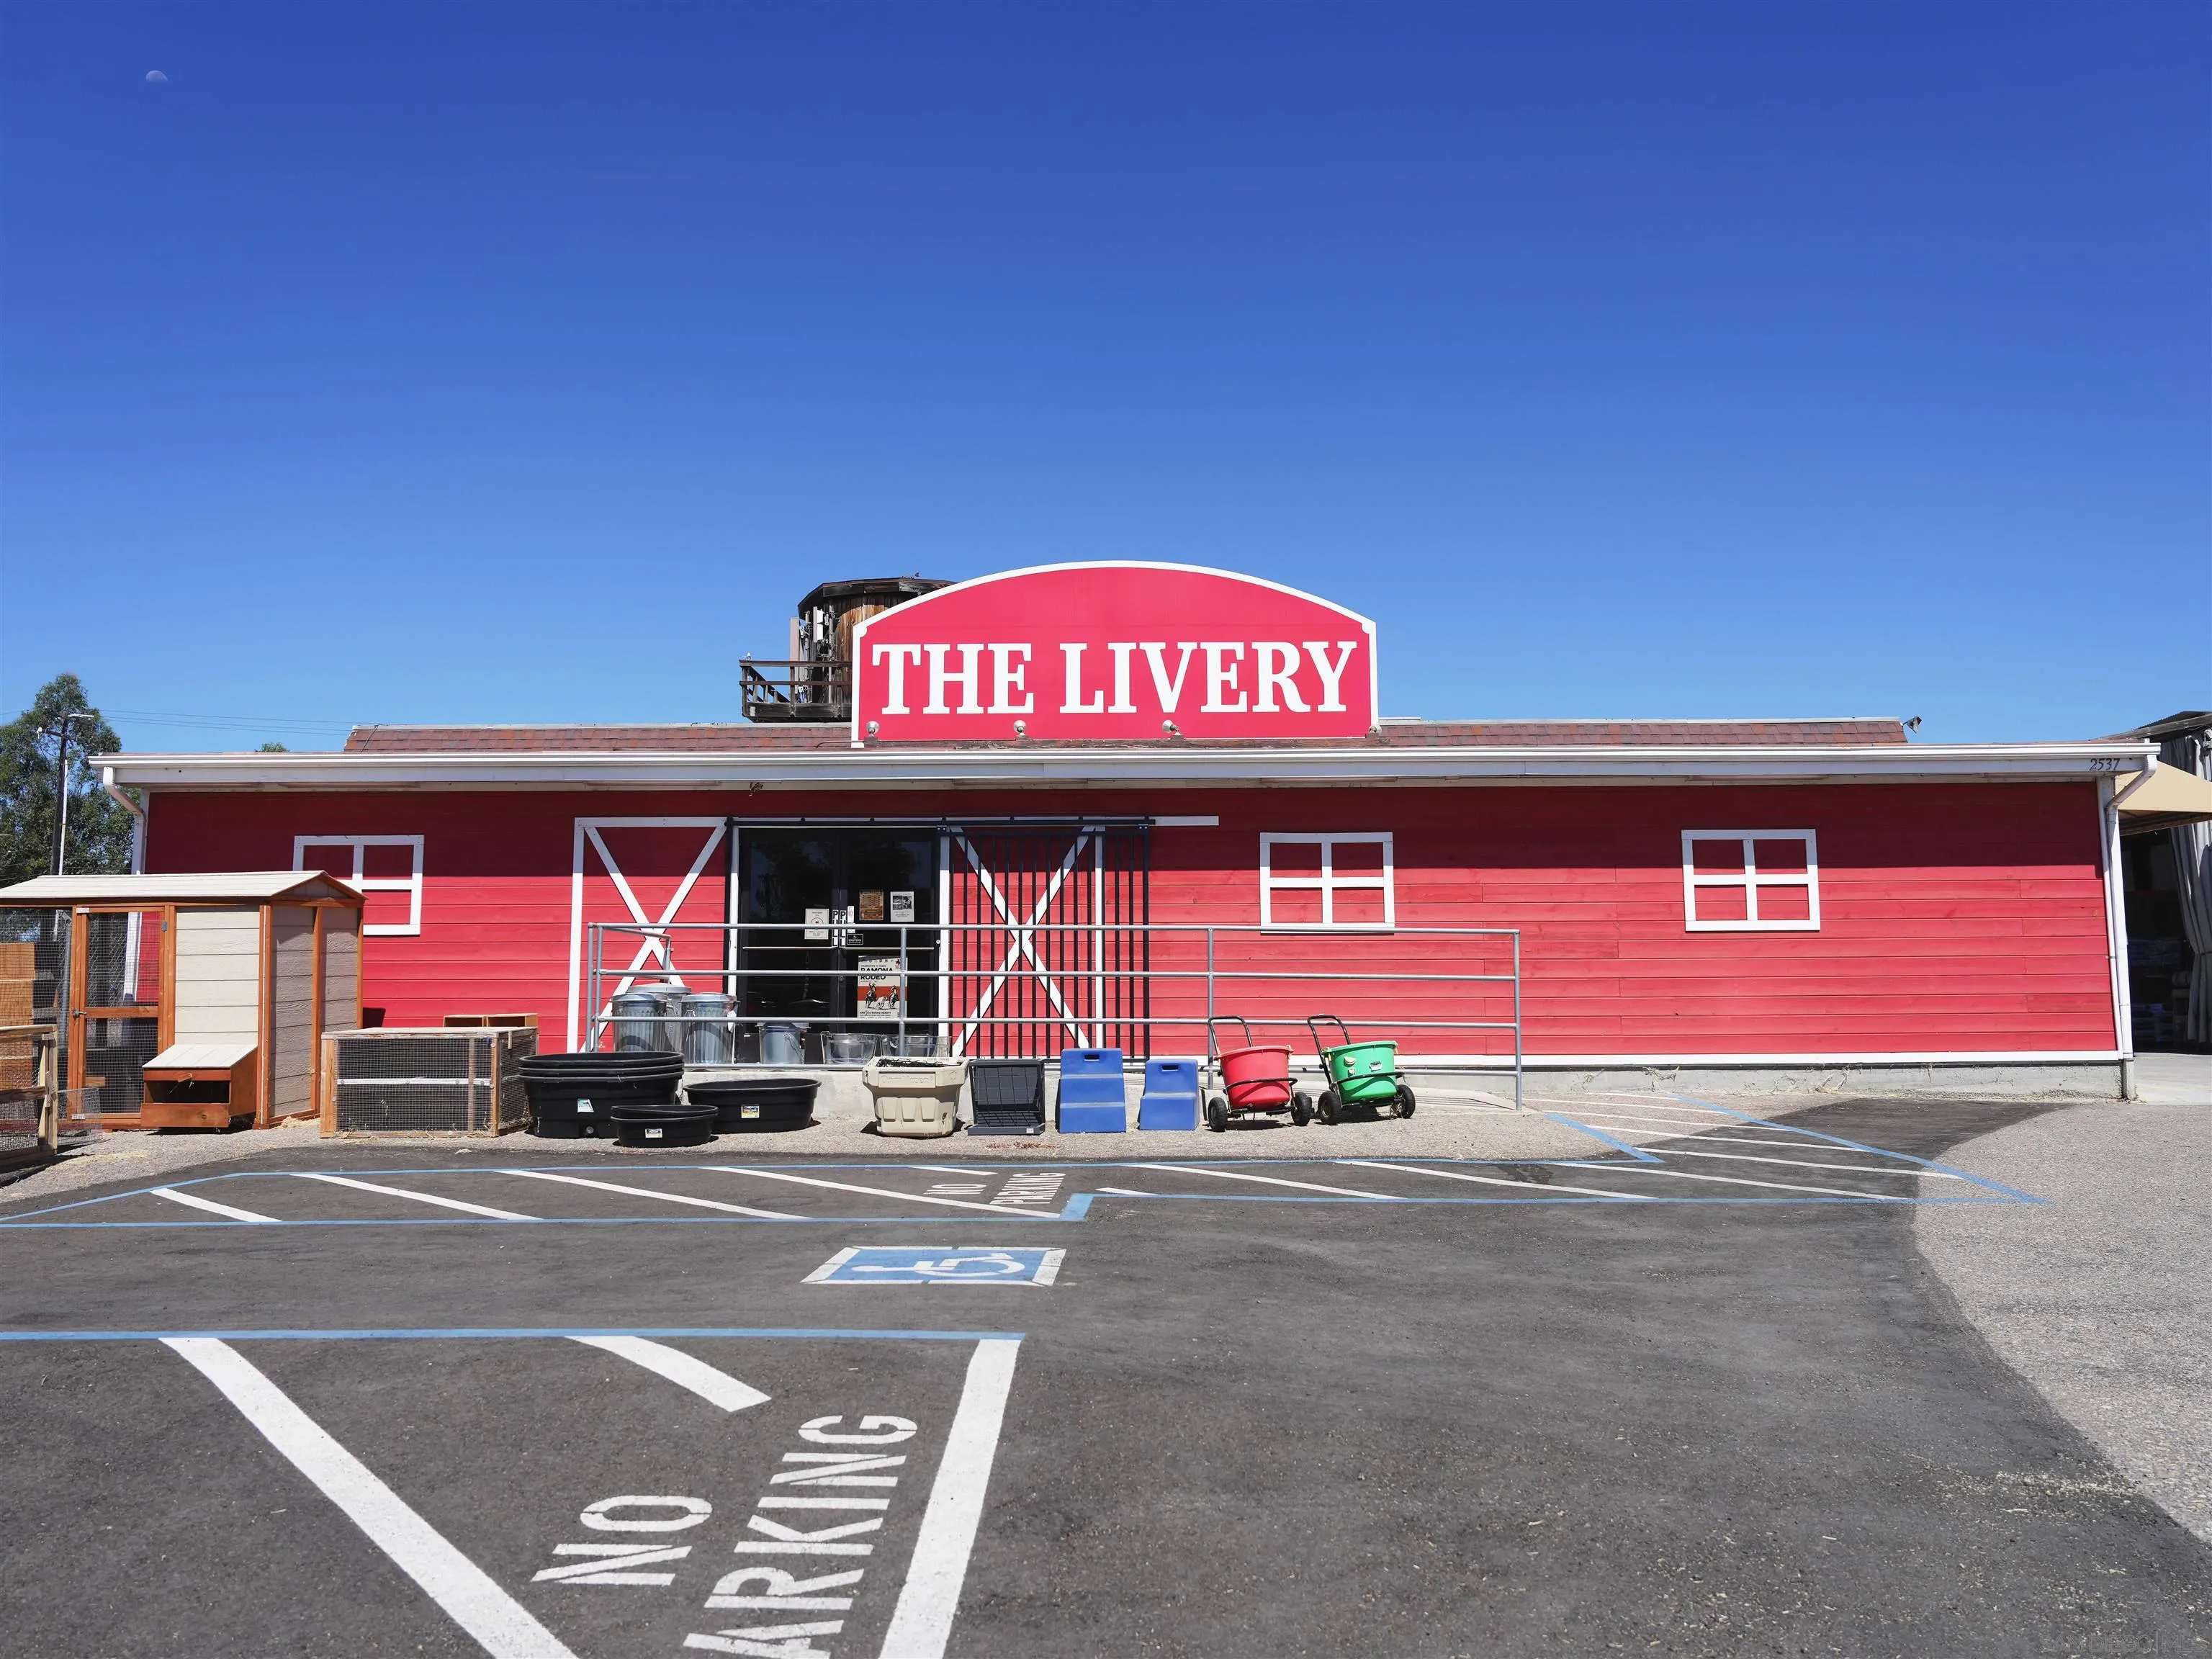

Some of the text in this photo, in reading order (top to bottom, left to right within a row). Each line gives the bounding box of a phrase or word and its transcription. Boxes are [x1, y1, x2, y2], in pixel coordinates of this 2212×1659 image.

[872, 641, 1357, 715] THE LIVERY
[2089, 758, 2121, 771] 2537
[923, 1184, 987, 1195] NO
[989, 1173, 1066, 1204] PARKING
[531, 1495, 713, 1586] NO
